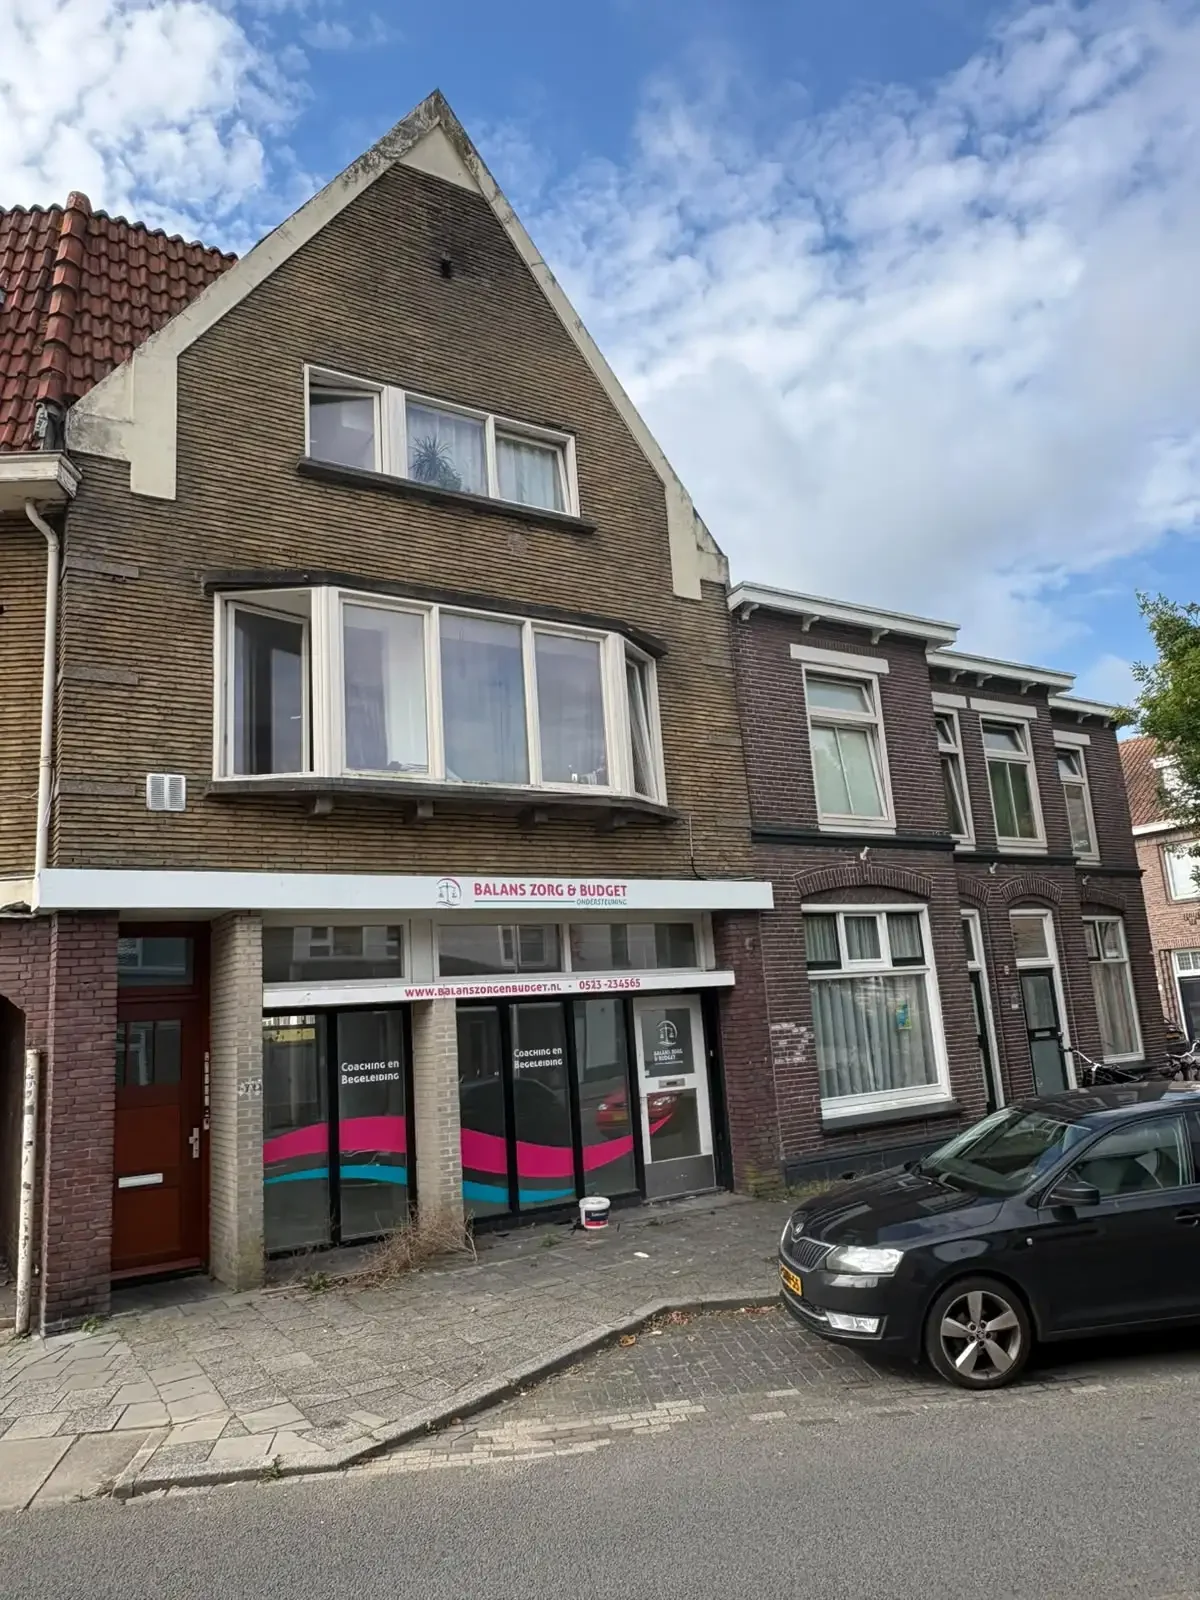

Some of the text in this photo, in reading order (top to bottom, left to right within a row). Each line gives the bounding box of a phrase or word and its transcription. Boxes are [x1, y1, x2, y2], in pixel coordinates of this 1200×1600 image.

[474, 882, 628, 898] BALANS ZORG & BUDGET
[341, 1060, 400, 1072] Coaching en
[341, 1072, 400, 1085] Begeleiding
